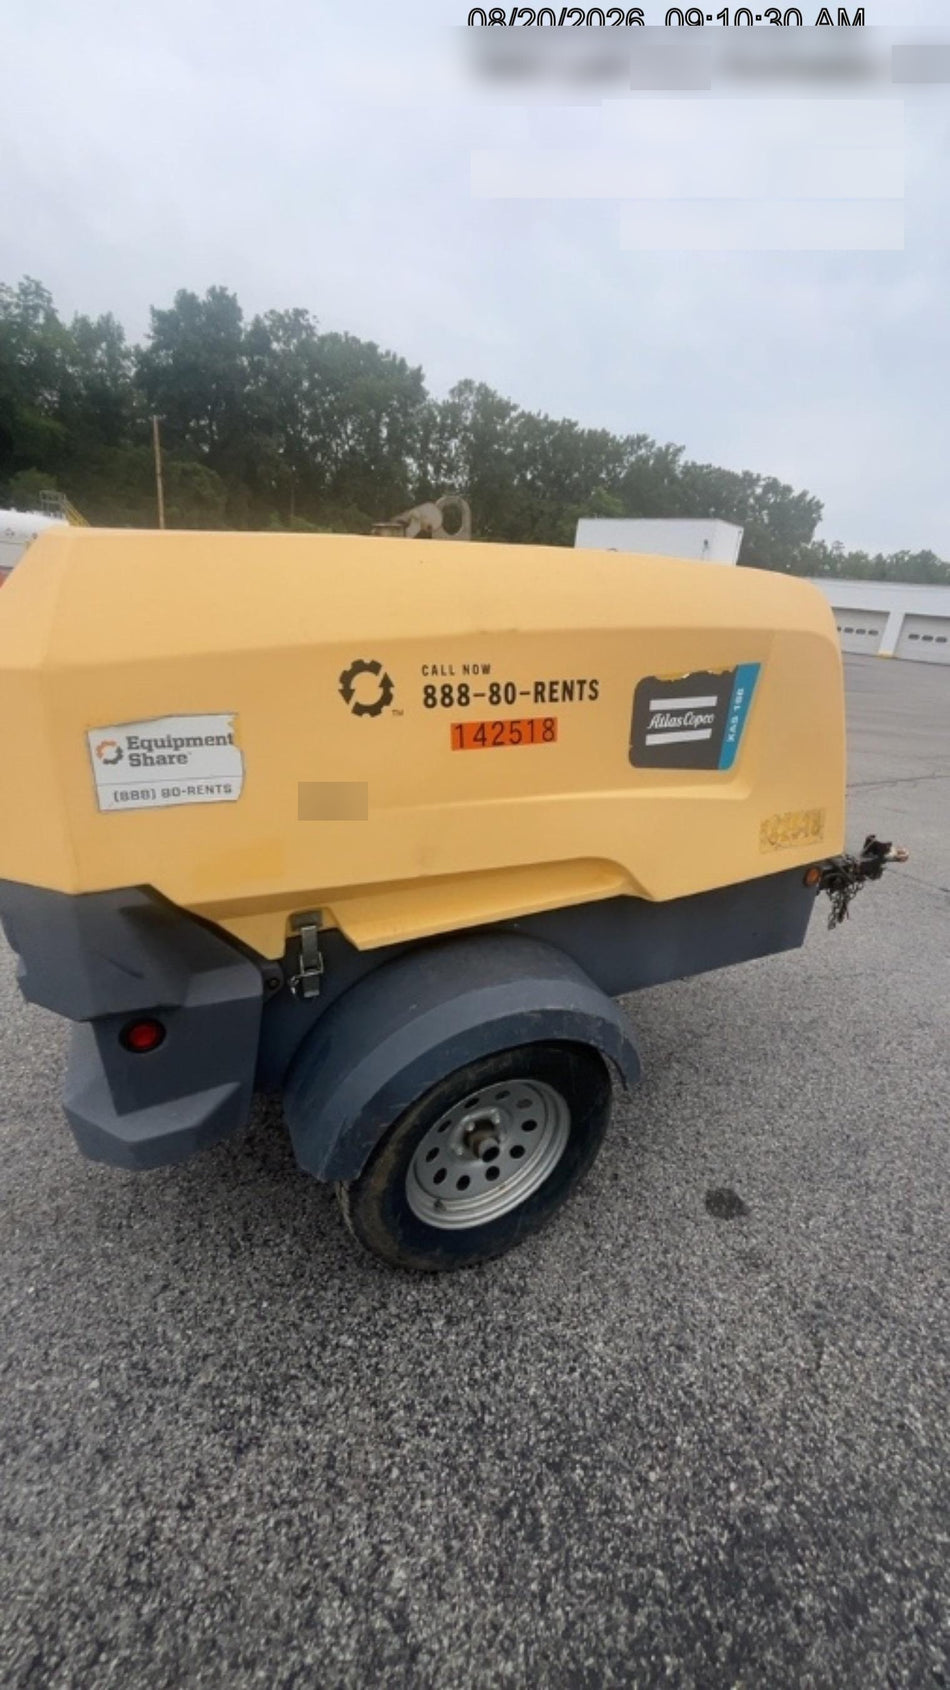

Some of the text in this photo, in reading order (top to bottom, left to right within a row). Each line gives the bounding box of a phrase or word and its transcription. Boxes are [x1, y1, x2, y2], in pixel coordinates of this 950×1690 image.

[421, 664, 492, 676] CALL NOW
[423, 679, 600, 709] 888-80-RENTS
[455, 718, 556, 749] 142518
[726, 715, 739, 742] XAS
[126, 733, 234, 752] Equipment
[128, 752, 189, 767] Share
[160, 783, 233, 799] 80-RENTS
